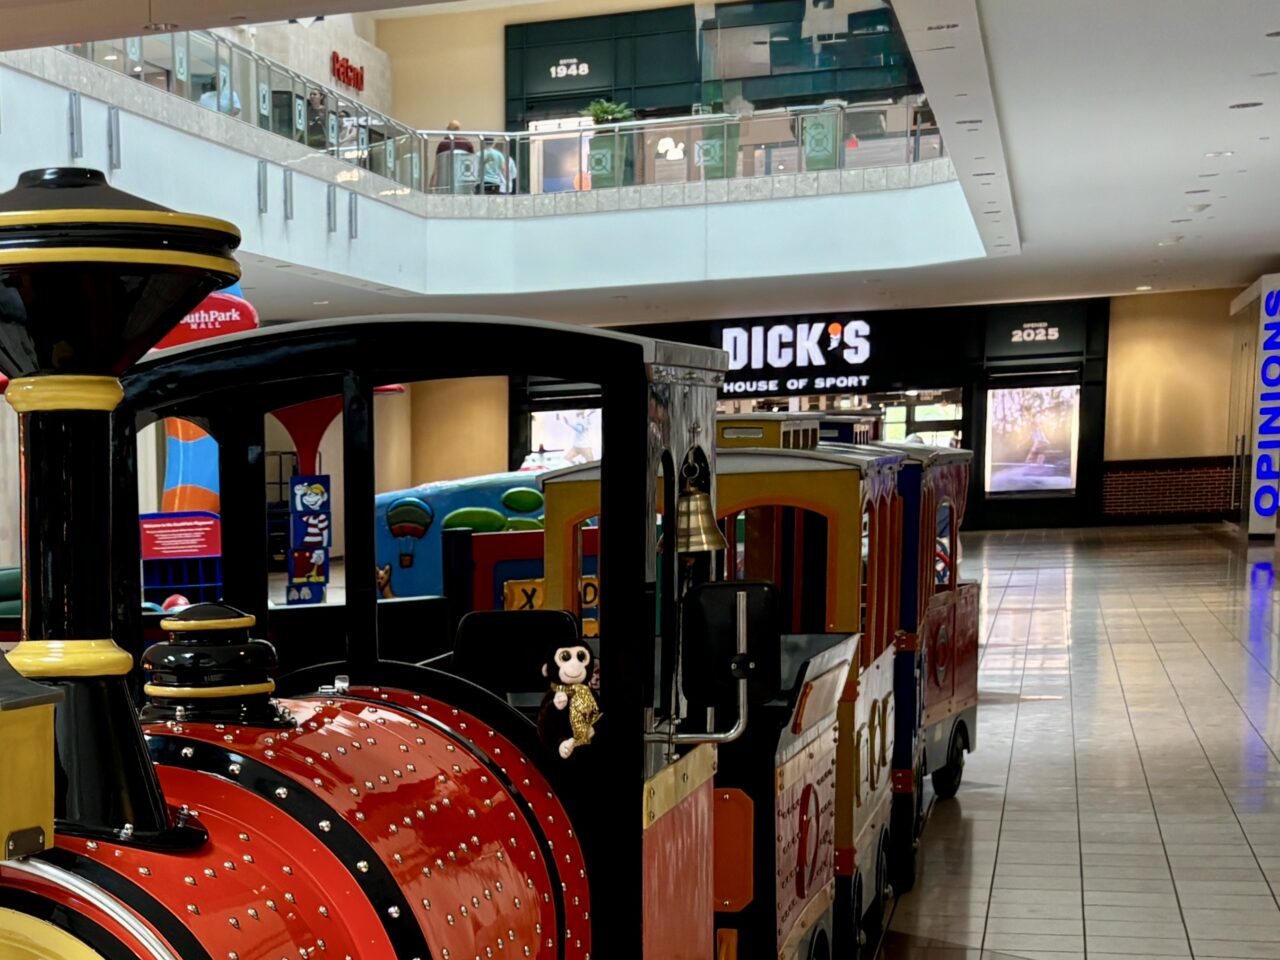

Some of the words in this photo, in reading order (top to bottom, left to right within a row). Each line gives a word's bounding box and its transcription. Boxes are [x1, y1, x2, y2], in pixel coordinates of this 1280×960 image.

[550, 63, 589, 78] 1948
[190, 321, 221, 330] MALL
[1011, 327, 1059, 342] 2025
[722, 320, 870, 371] DICK'S
[723, 380, 779, 393] HOUSE
[786, 378, 808, 389] OF
[814, 375, 870, 388] SPORT
[1254, 289, 1280, 517] OPINIONS
[519, 587, 537, 609] X
[582, 582, 598, 605] D
